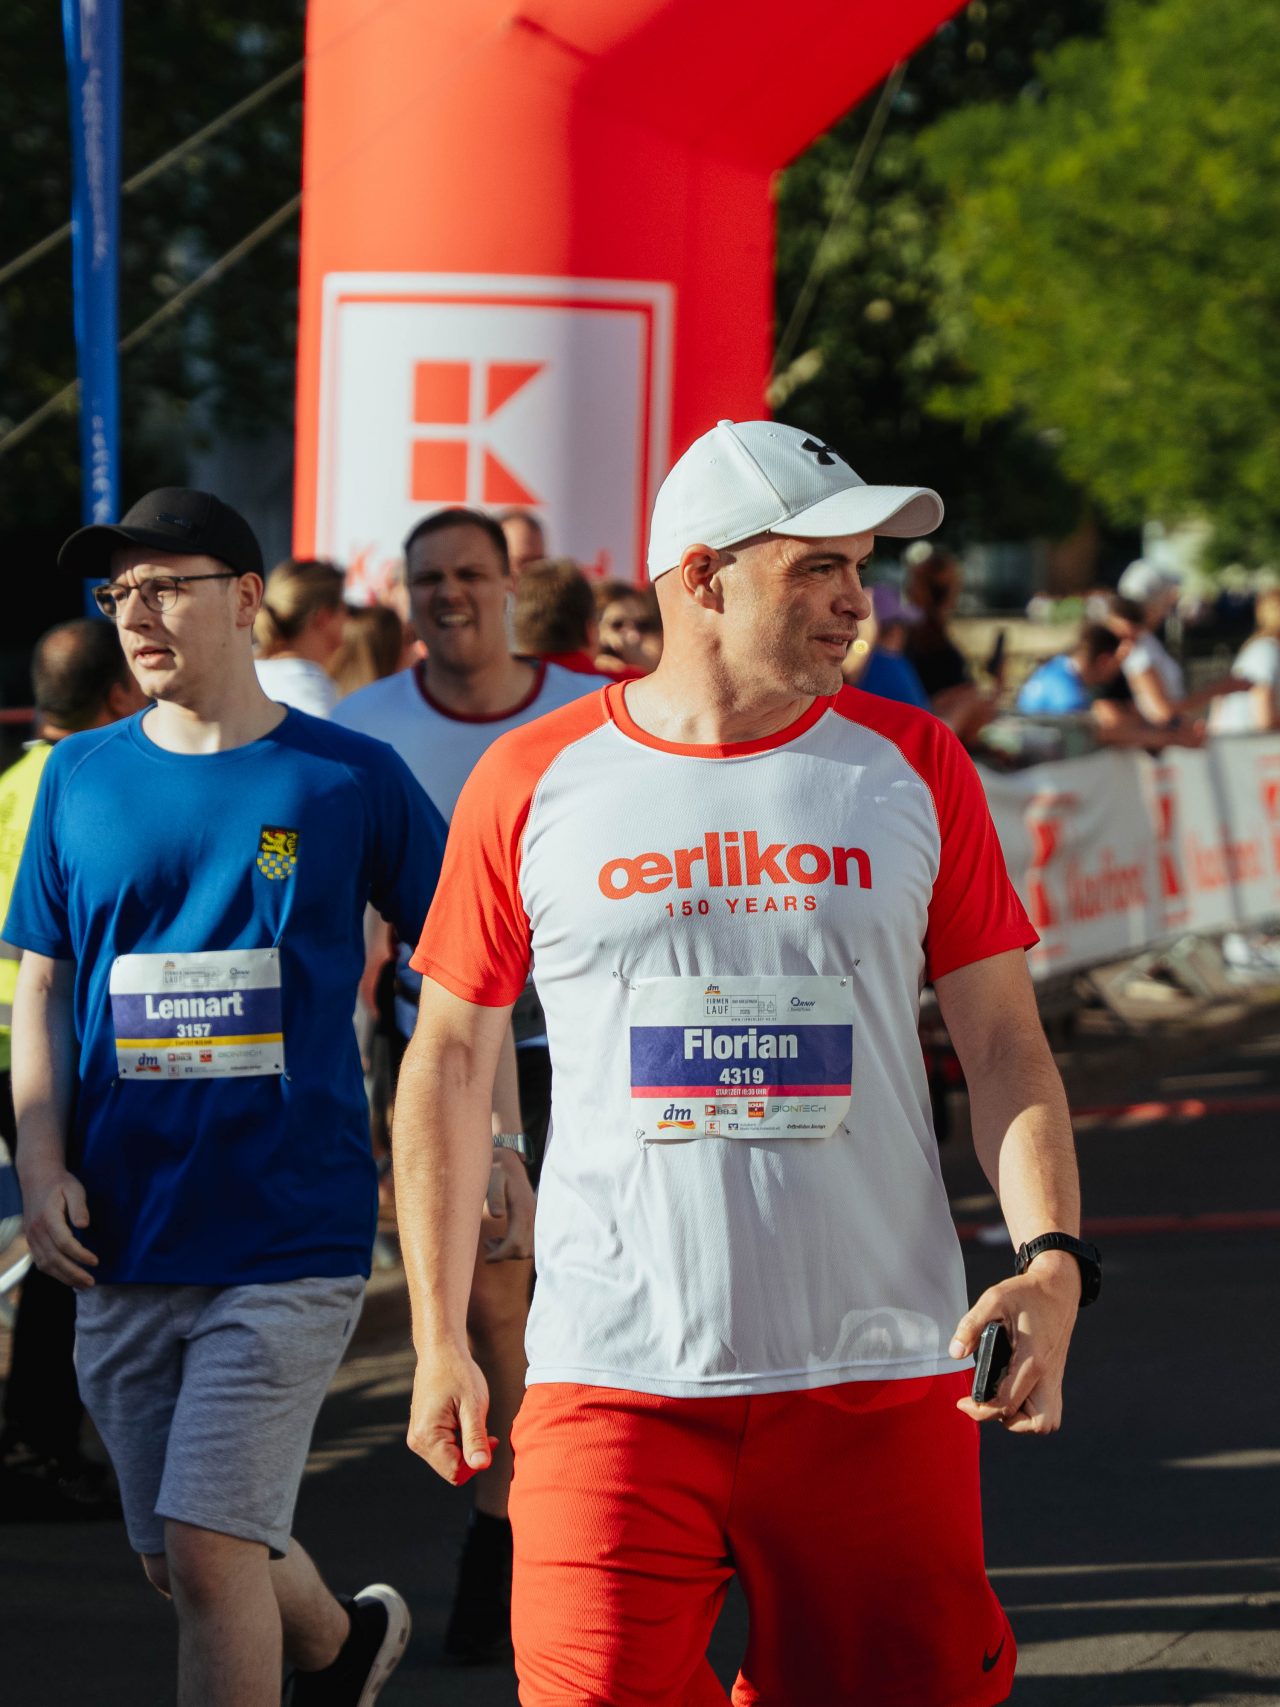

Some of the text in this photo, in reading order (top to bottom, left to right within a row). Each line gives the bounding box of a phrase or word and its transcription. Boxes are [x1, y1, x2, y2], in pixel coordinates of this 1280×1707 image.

[665, 895, 817, 918] 150 YEARS
[145, 992, 244, 1020] Lennart
[706, 1006, 729, 1015] LAUF
[176, 1024, 212, 1037] 3157
[683, 1028, 798, 1060] Florian
[138, 1053, 158, 1066] dm
[719, 1067, 764, 1085] 4319
[663, 1103, 692, 1121] dm
[771, 1104, 827, 1113] BIONTECH
